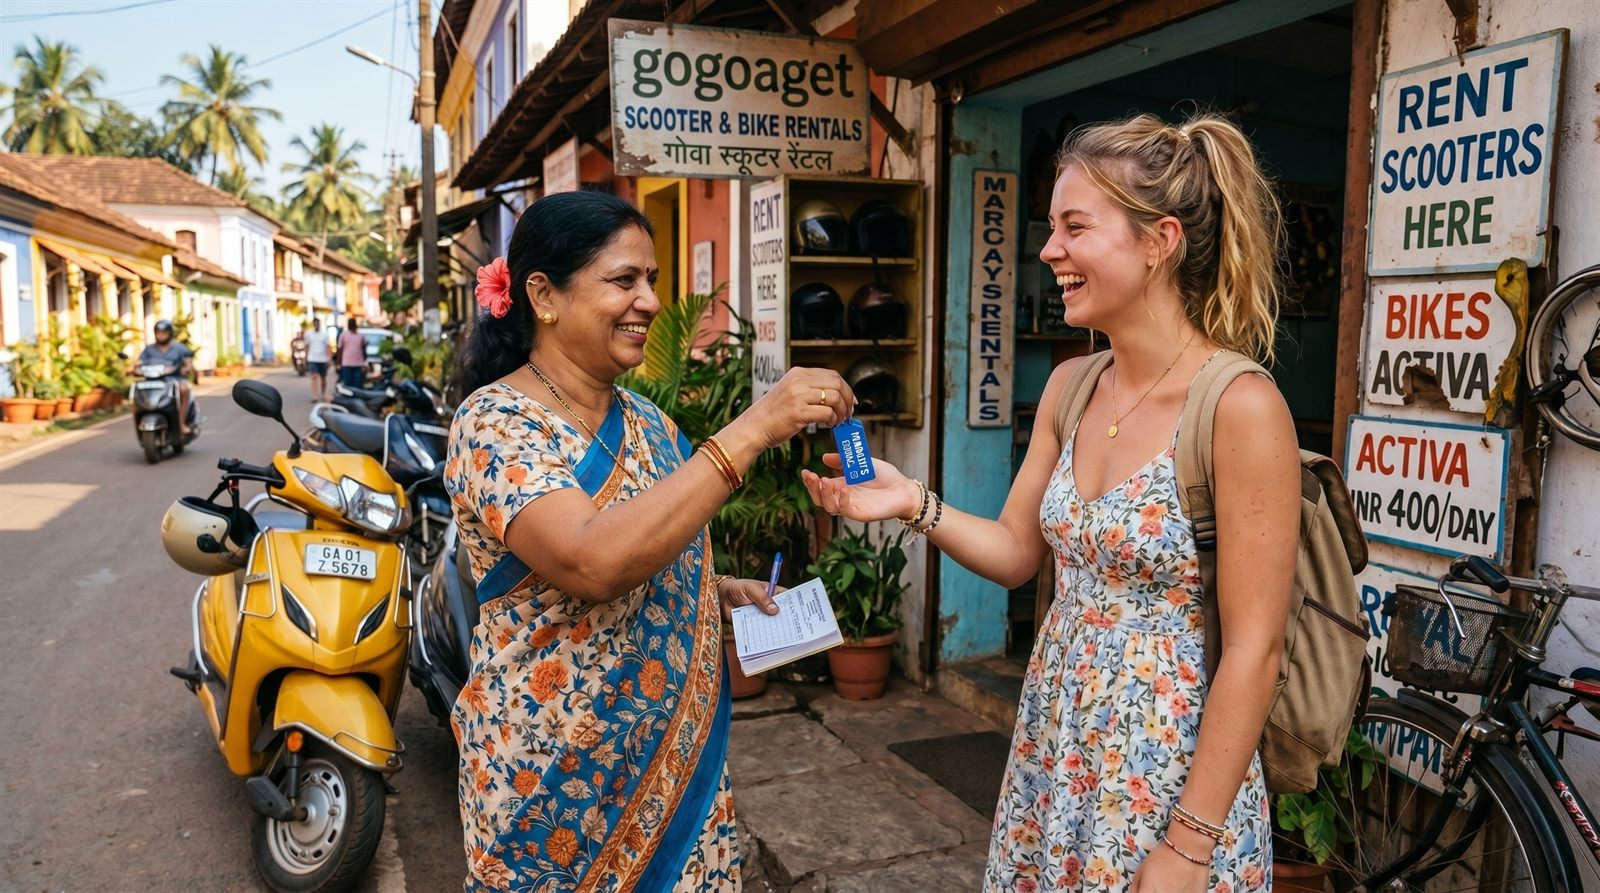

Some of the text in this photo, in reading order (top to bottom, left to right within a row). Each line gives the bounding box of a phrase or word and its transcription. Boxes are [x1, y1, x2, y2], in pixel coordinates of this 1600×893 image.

[632, 48, 854, 107] gogoaget
[1397, 57, 1529, 134] RENT
[624, 105, 862, 142] SCOOTER & BIKE RENTALS
[663, 135, 833, 176] गोवा स्कूटर रेंटल
[1380, 123, 1544, 194] SCOOTERS
[753, 193, 781, 234] RENT
[1403, 195, 1494, 250] HERE
[752, 238, 784, 267] SCOOTERS
[757, 274, 777, 301] HERE
[1385, 291, 1492, 341] BIKES
[1355, 432, 1470, 488] ACTIVA
[1387, 488, 1496, 545] 400/DAY
[322, 547, 361, 562] GA 01
[331, 561, 368, 576] 5678
